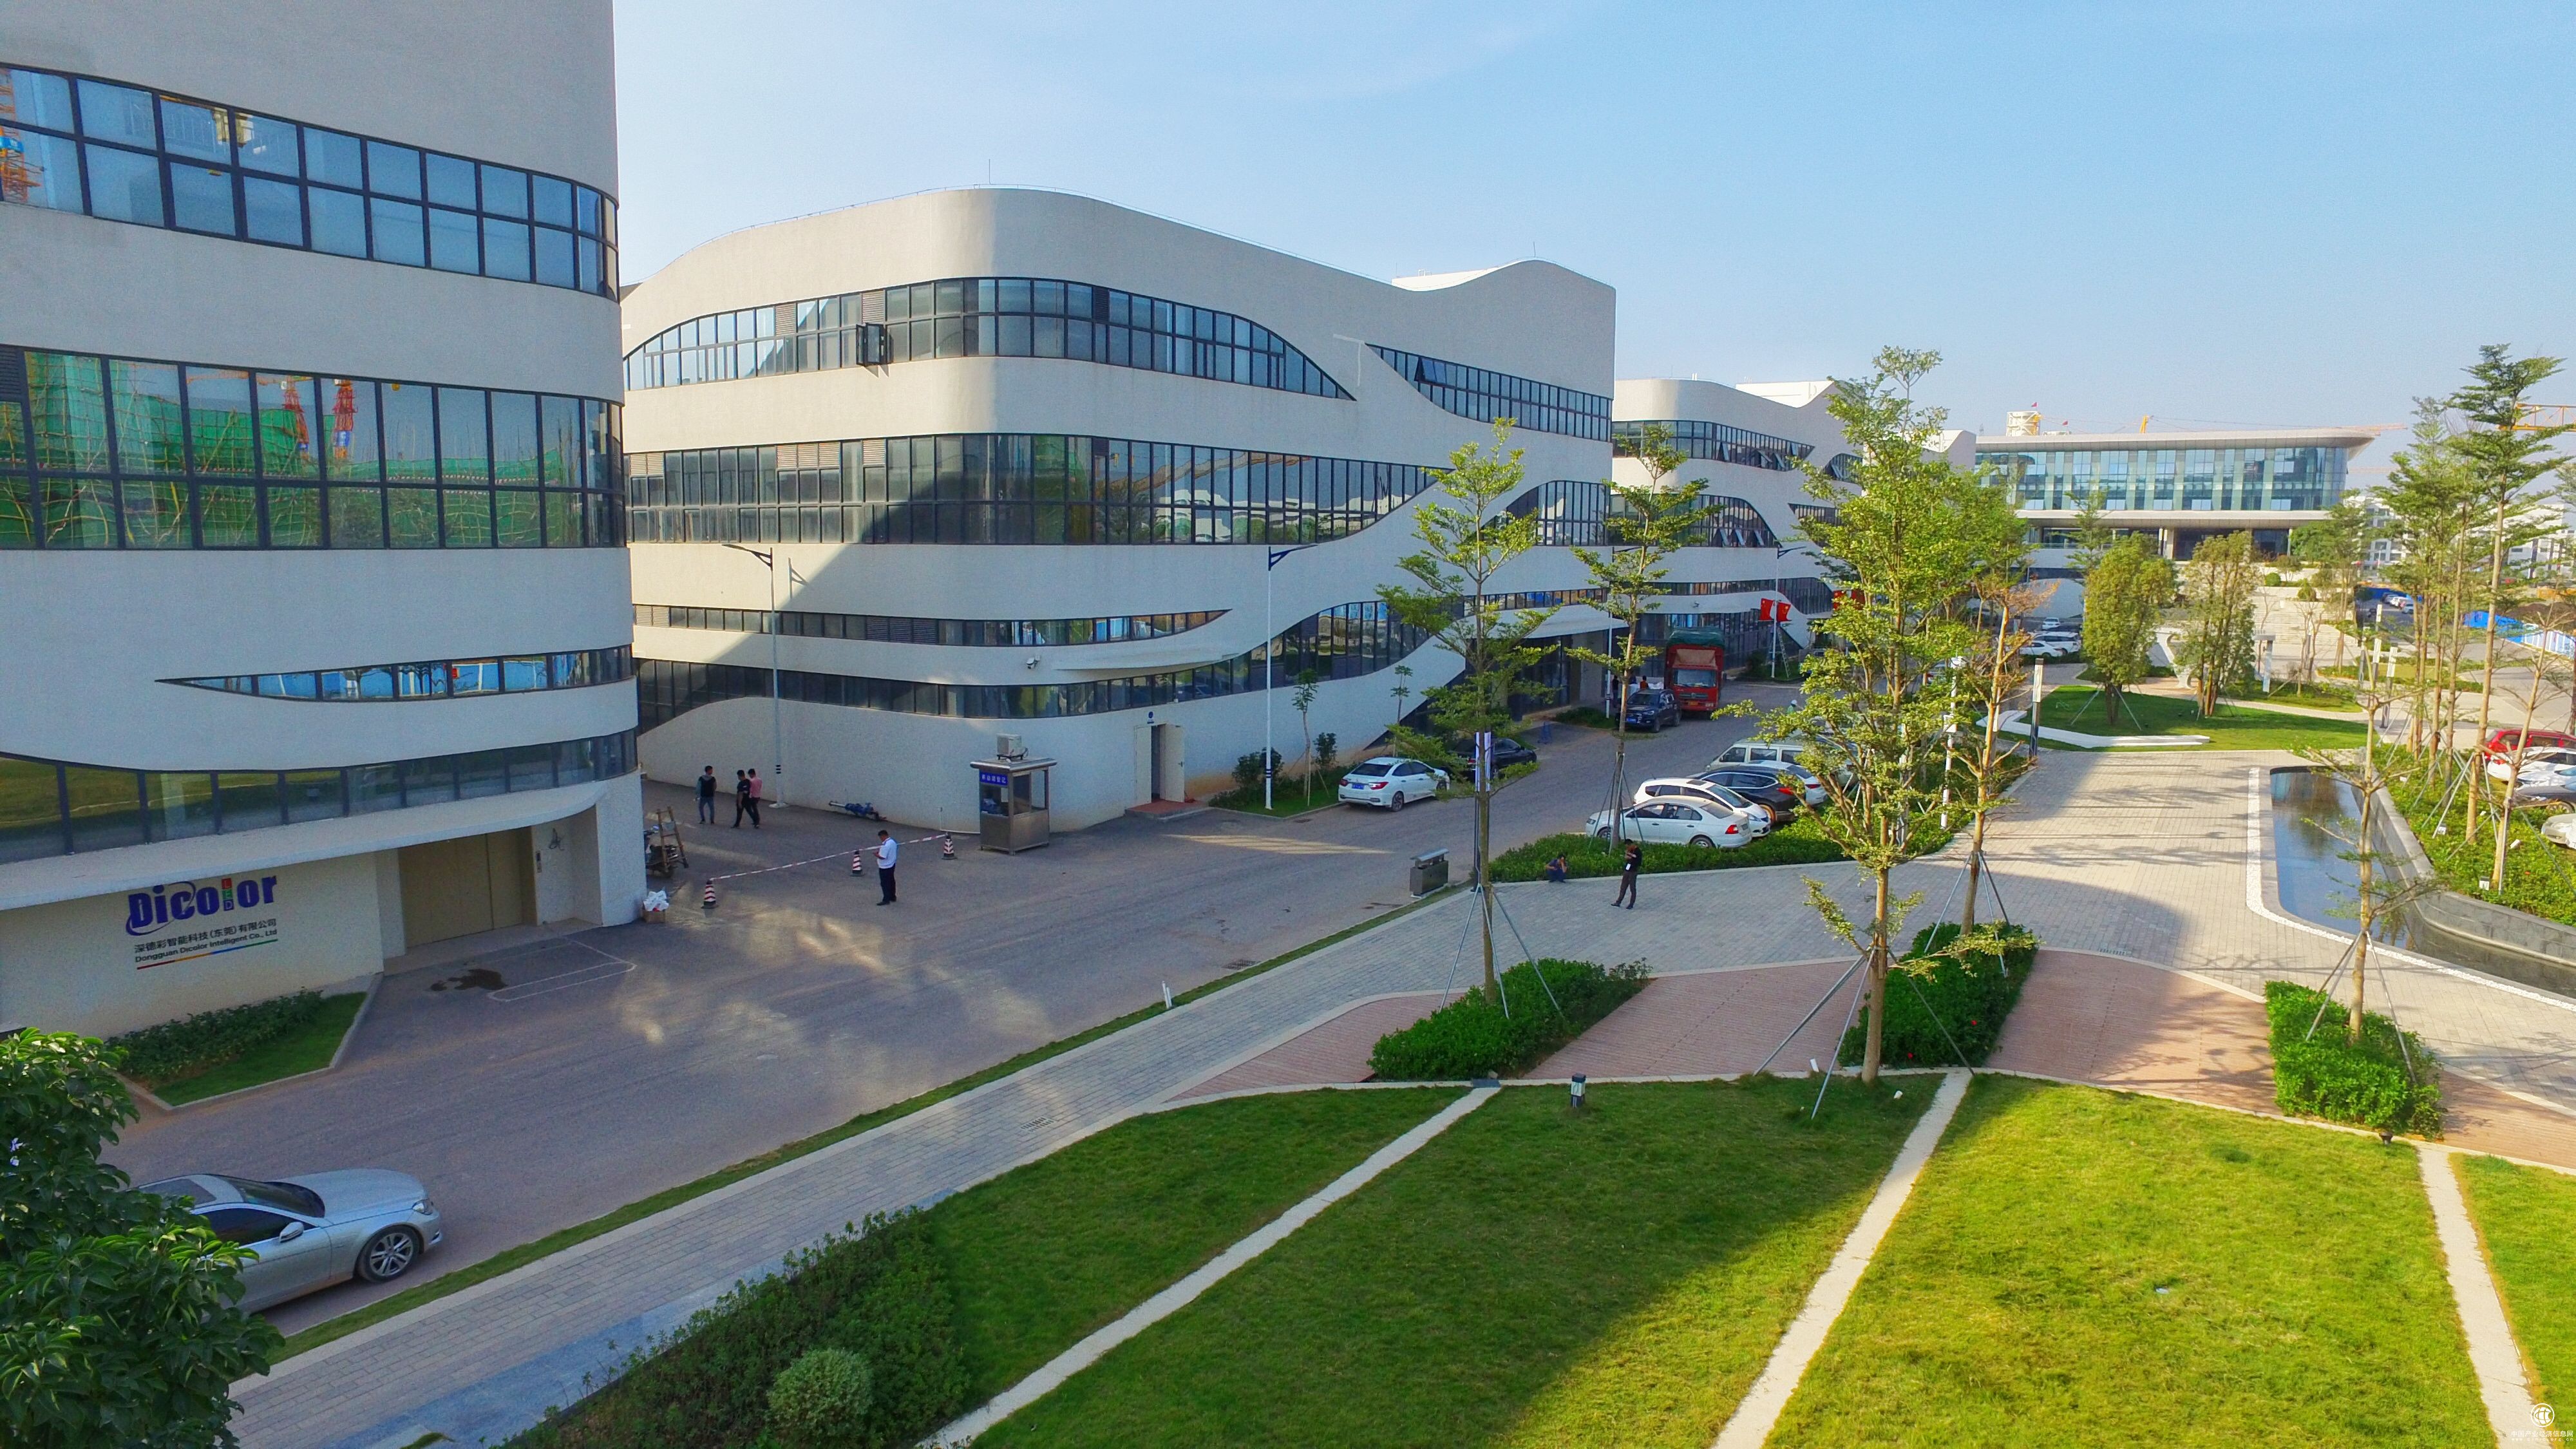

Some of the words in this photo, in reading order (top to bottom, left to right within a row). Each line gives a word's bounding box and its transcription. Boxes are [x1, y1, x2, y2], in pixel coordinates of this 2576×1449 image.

[128, 875, 278, 929] Dicolor
[135, 949, 178, 962] Dongguan
[180, 943, 207, 954] Dicolor
[210, 934, 247, 947] Intelligent
